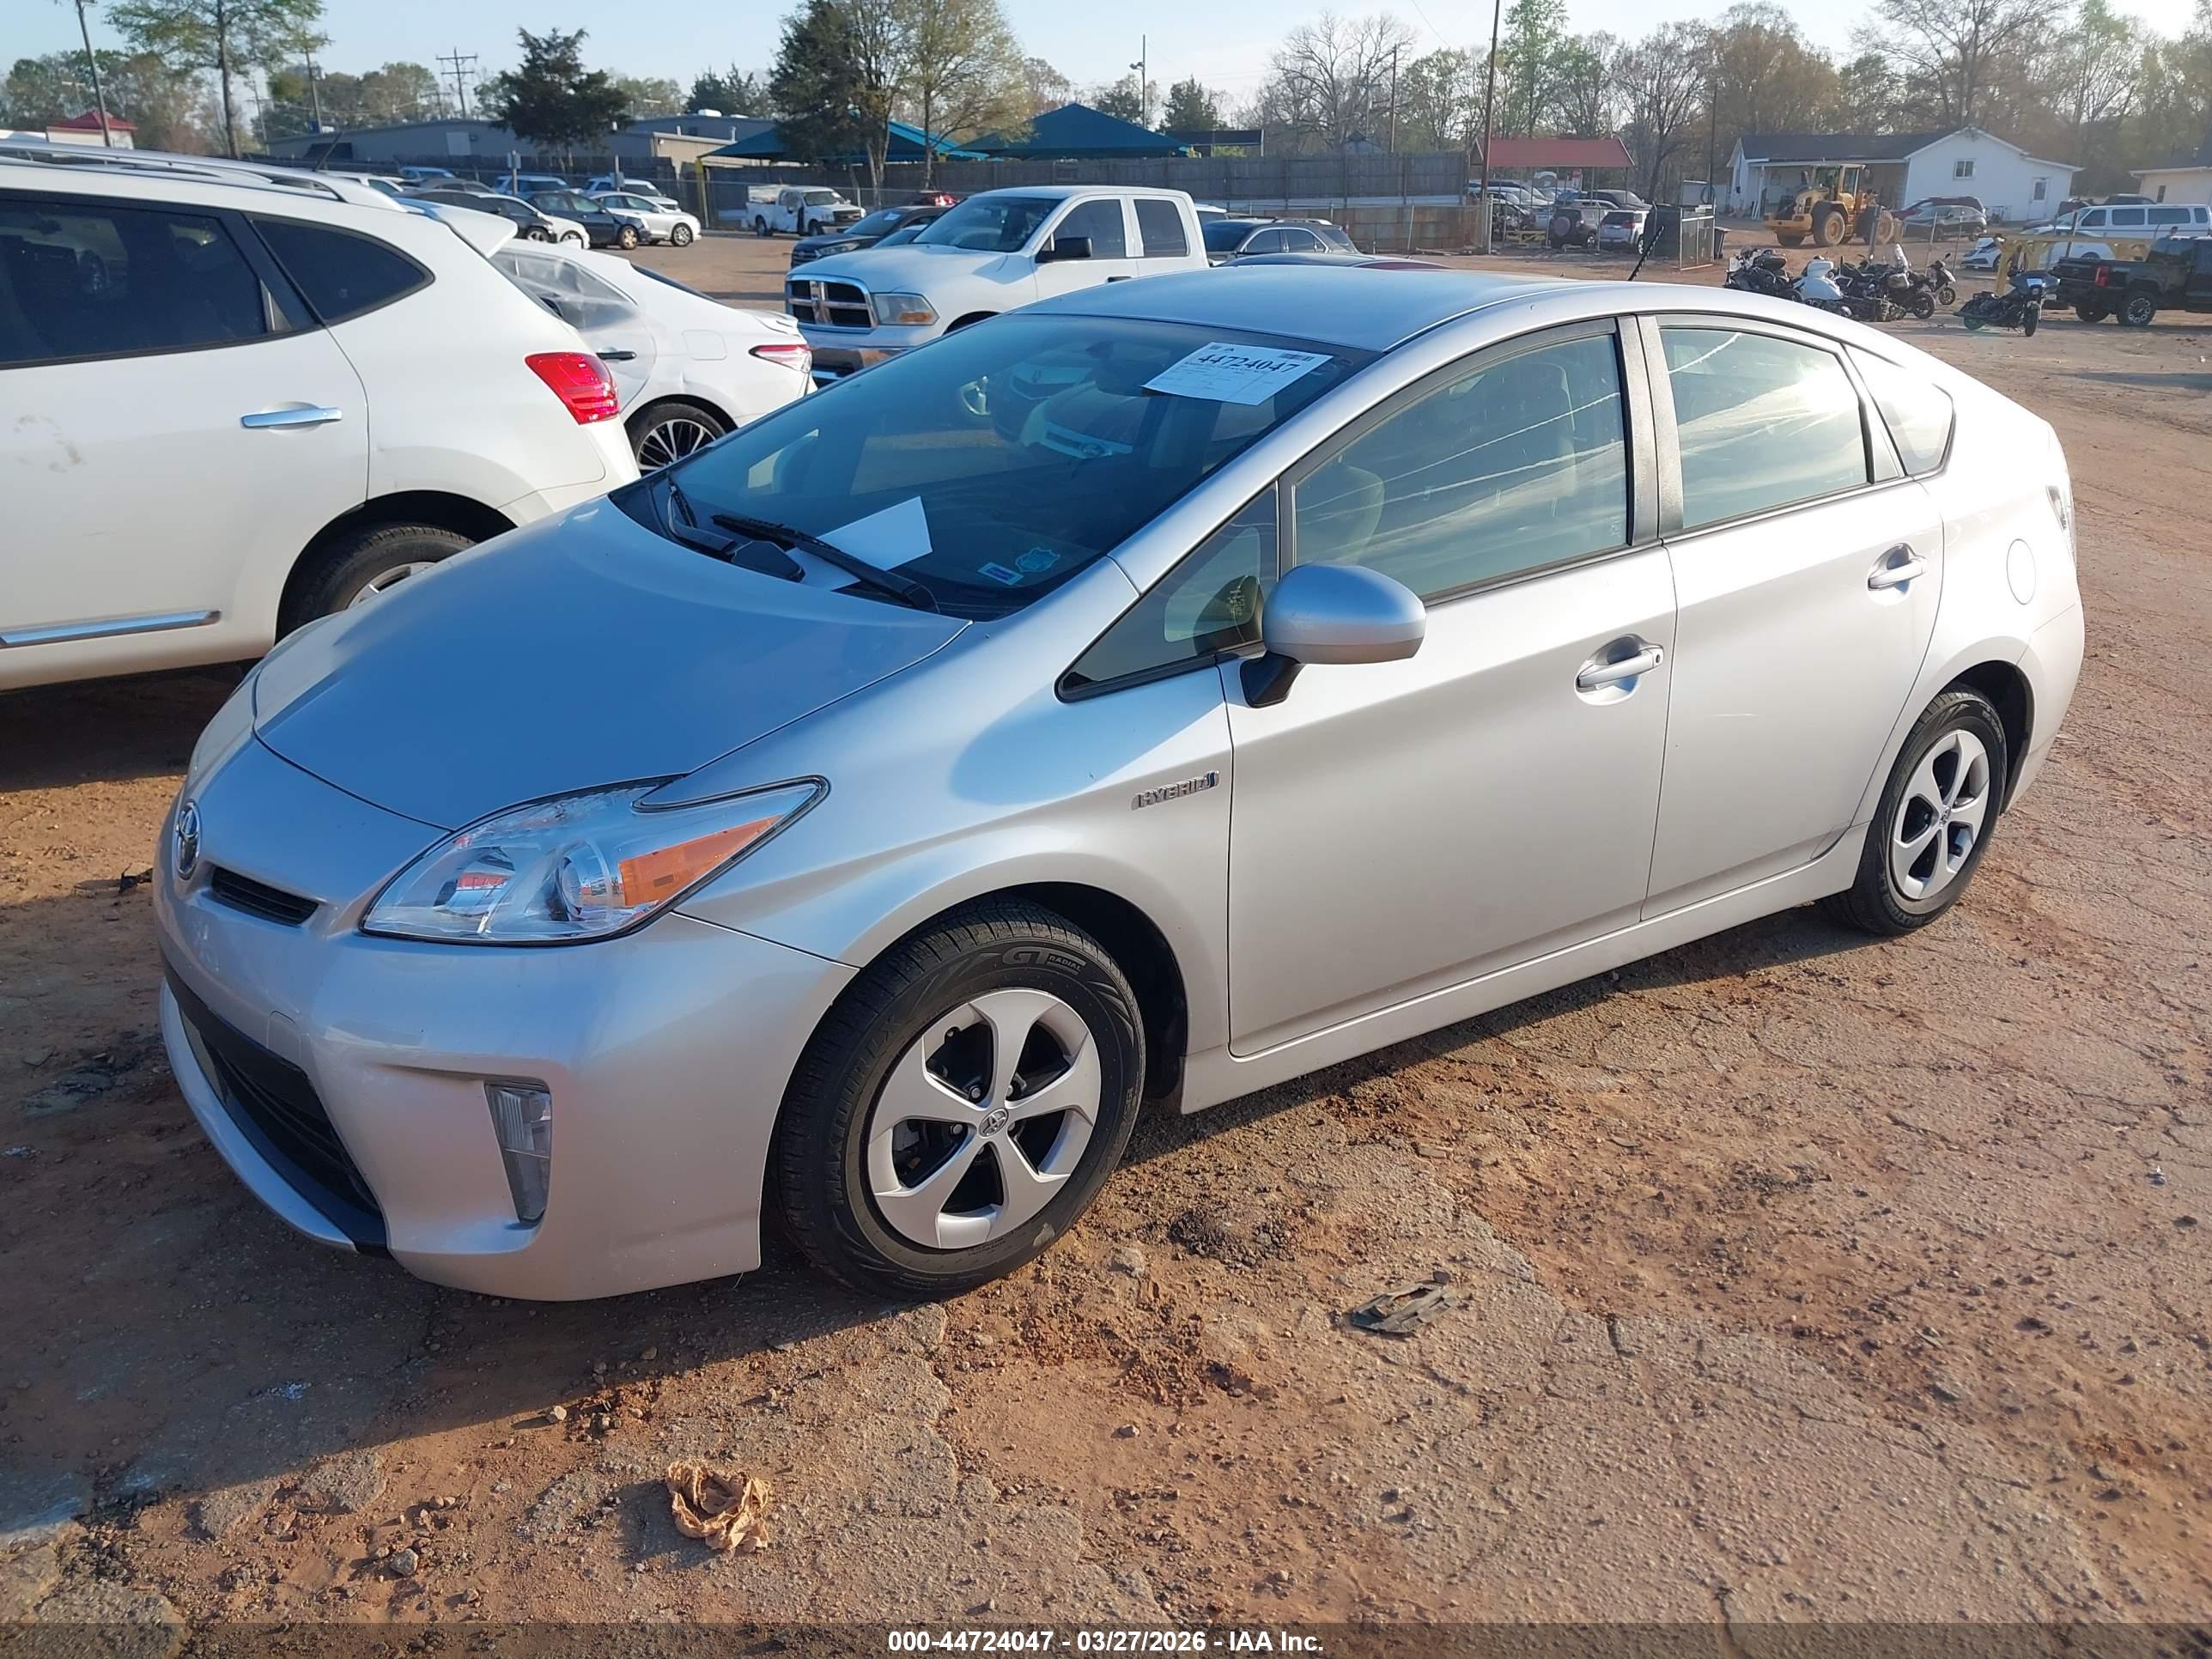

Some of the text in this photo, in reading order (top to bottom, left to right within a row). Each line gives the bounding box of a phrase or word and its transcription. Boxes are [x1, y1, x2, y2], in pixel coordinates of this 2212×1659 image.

[1198, 353, 1300, 373] 44724047
[1136, 774, 1209, 808] HYBRID
[1048, 955, 1082, 972] RADIAL
